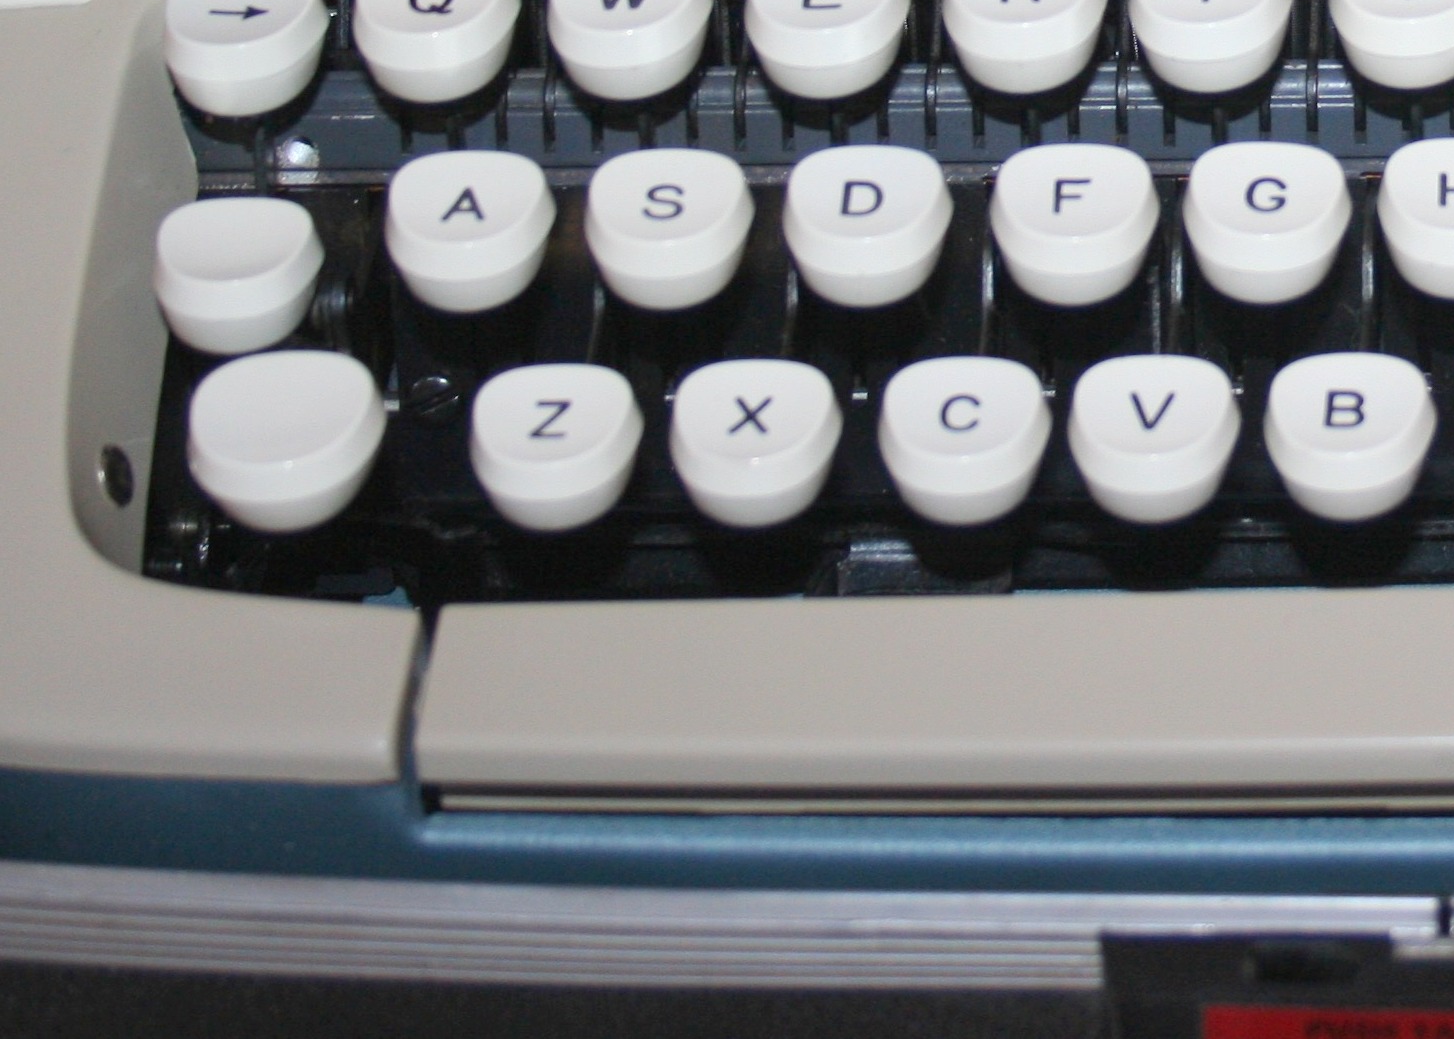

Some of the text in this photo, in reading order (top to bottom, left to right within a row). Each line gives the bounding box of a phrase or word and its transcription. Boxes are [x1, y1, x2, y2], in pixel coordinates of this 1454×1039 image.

[441, 187, 485, 222] A
[643, 184, 684, 221] S
[840, 180, 884, 216] D
[1053, 179, 1091, 214] F
[1245, 177, 1287, 213] G
[529, 400, 571, 439] Z
[729, 398, 772, 434] X
[939, 394, 981, 432] C
[1131, 392, 1175, 431] V
[1324, 390, 1365, 428] B
